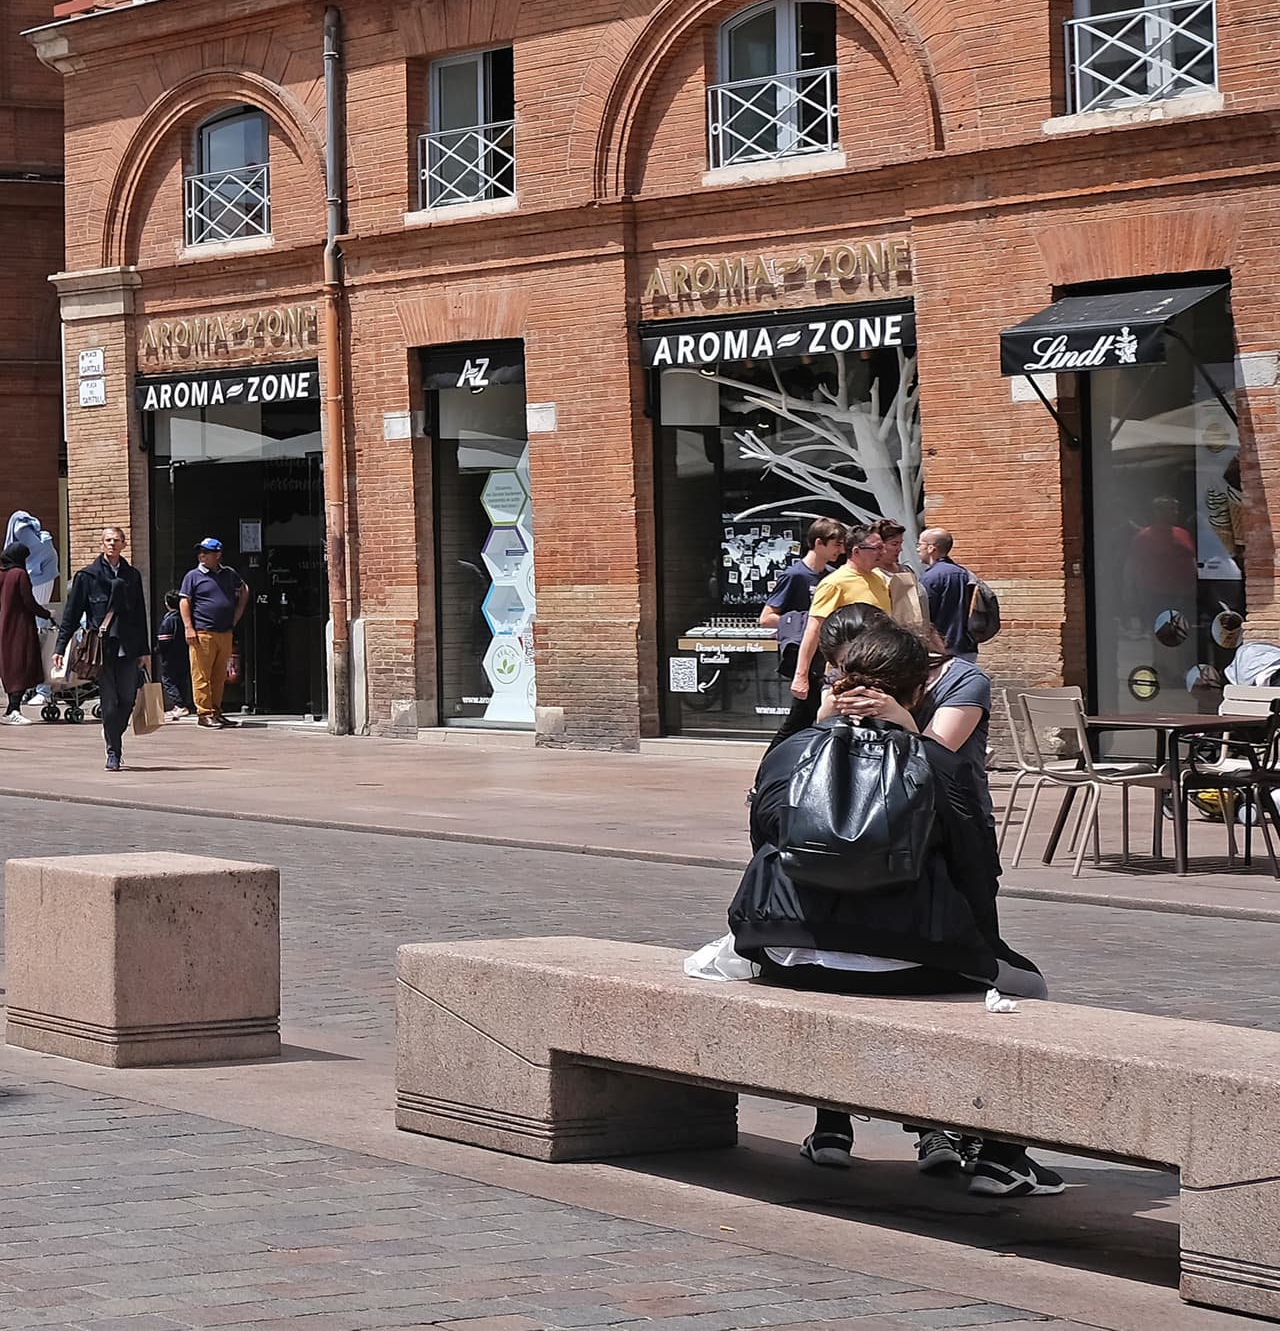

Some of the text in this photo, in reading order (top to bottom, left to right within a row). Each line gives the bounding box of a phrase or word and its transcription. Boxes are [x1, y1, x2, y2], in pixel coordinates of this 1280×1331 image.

[645, 240, 910, 296] AROMA ZONE
[140, 306, 318, 348] AROMA ZONE
[653, 316, 902, 366] AROMA ZONE
[1023, 335, 1115, 370] Lindt
[143, 372, 310, 410] AROMA ZONE
[456, 358, 490, 387] AZ
[755, 707, 790, 715] www.aro
